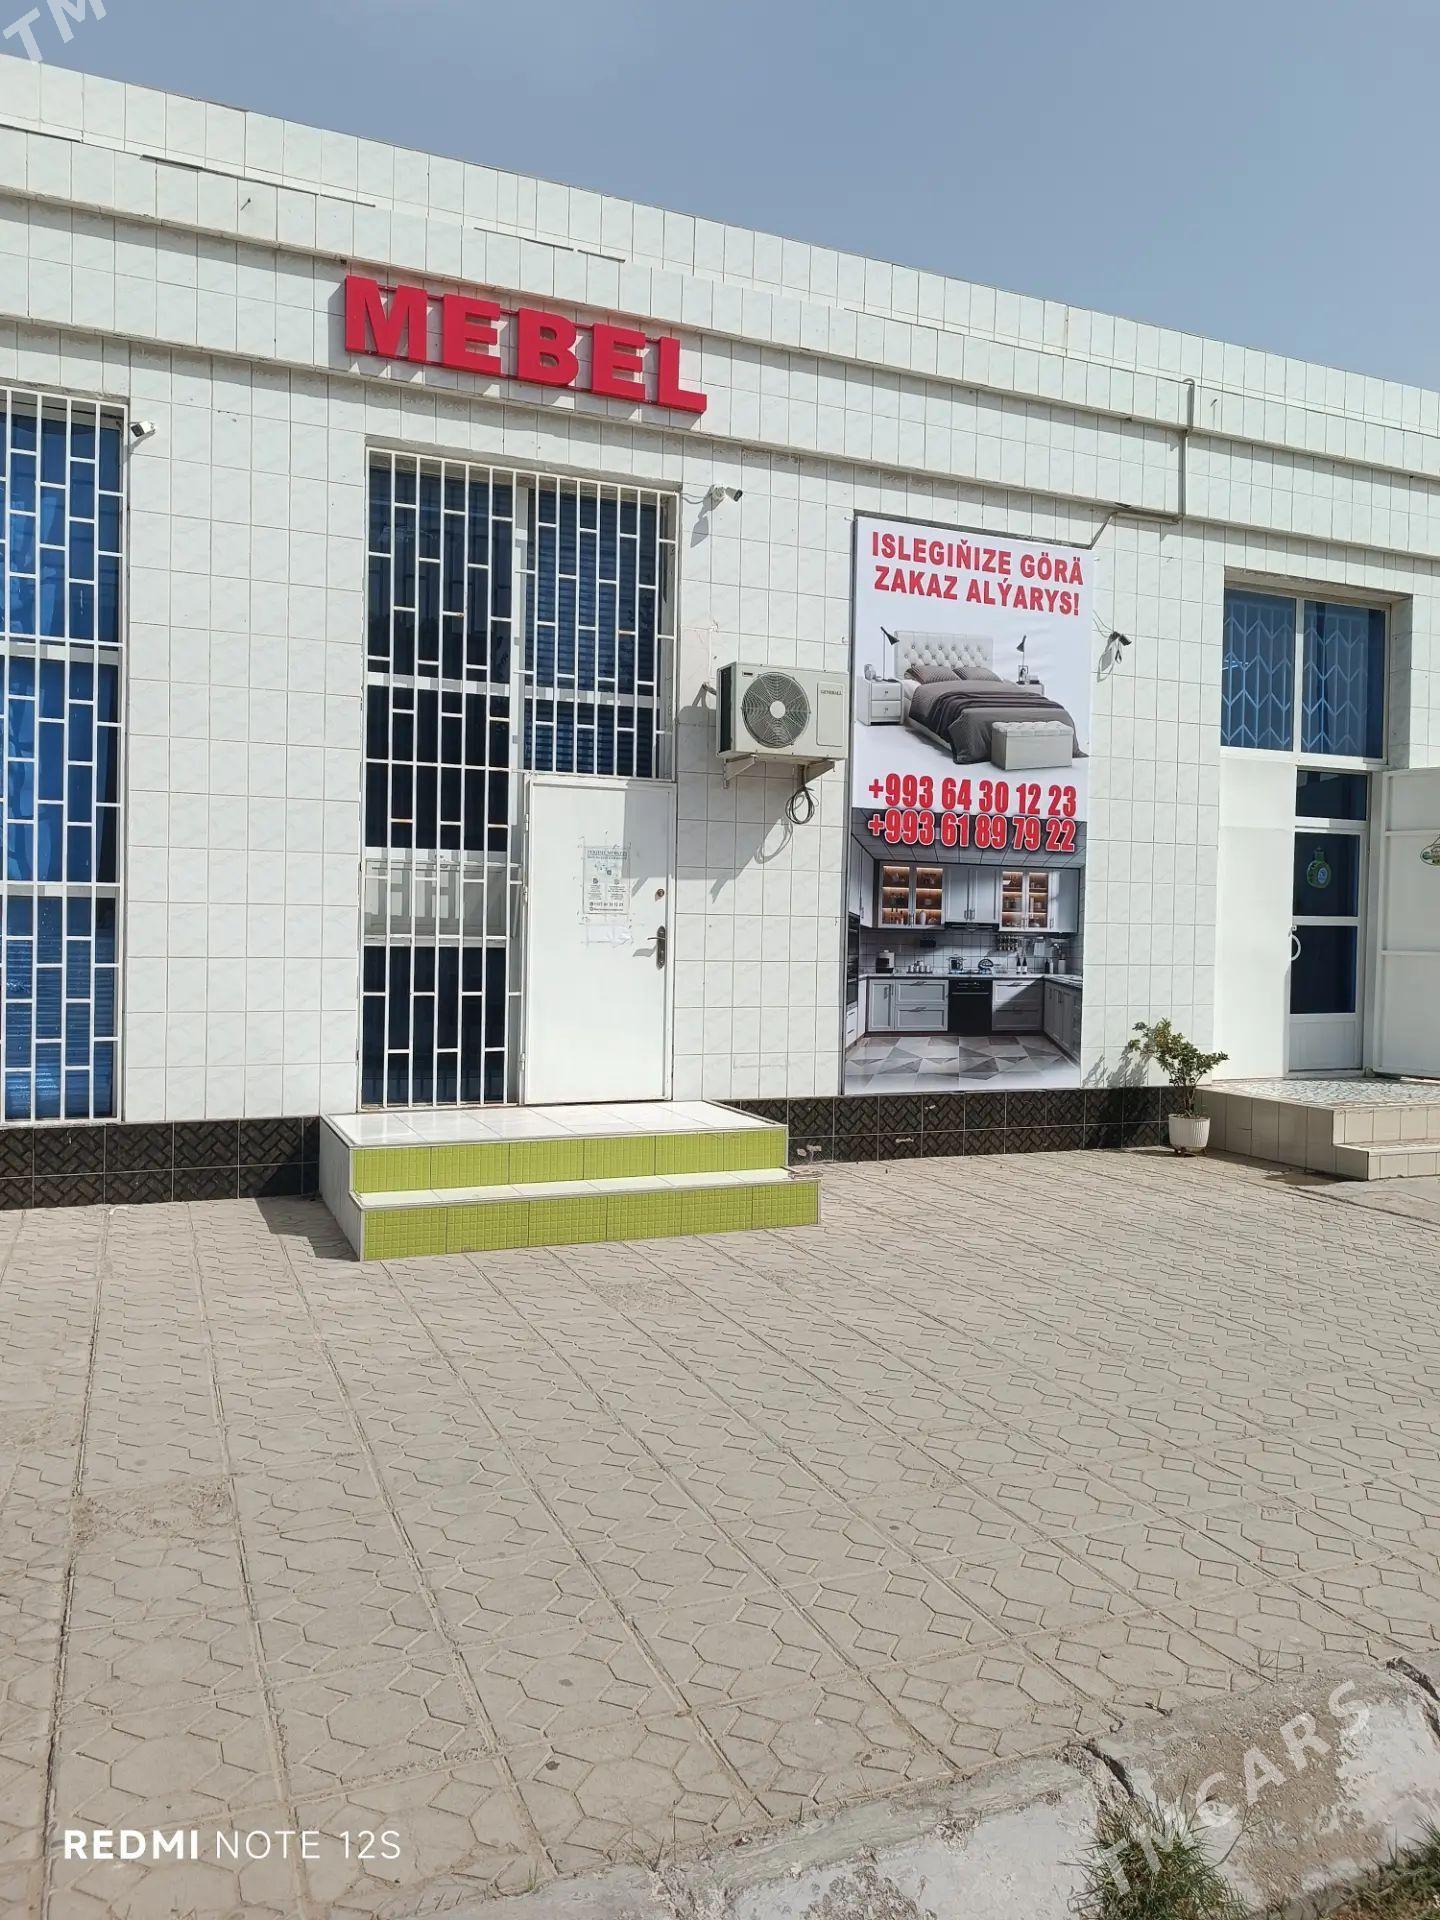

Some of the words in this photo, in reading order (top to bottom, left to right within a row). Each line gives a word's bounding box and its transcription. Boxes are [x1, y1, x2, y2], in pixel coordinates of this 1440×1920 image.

[345, 275, 708, 414] MEBEL
[872, 531, 1012, 576] ISLEGIŇIZE
[1020, 551, 1084, 586] GÖRÄ
[874, 565, 958, 600] ZAKAZ
[966, 577, 1080, 616] ALÝARYS!
[868, 773, 934, 808] +993
[941, 777, 972, 811] 64
[979, 780, 1009, 813] 30
[1016, 783, 1041, 815] 12
[1048, 785, 1077, 817] 23
[867, 808, 935, 845] +993
[941, 811, 970, 847] 61
[975, 813, 1007, 849] 89
[1013, 816, 1041, 851] 79
[1046, 817, 1077, 852] 22
